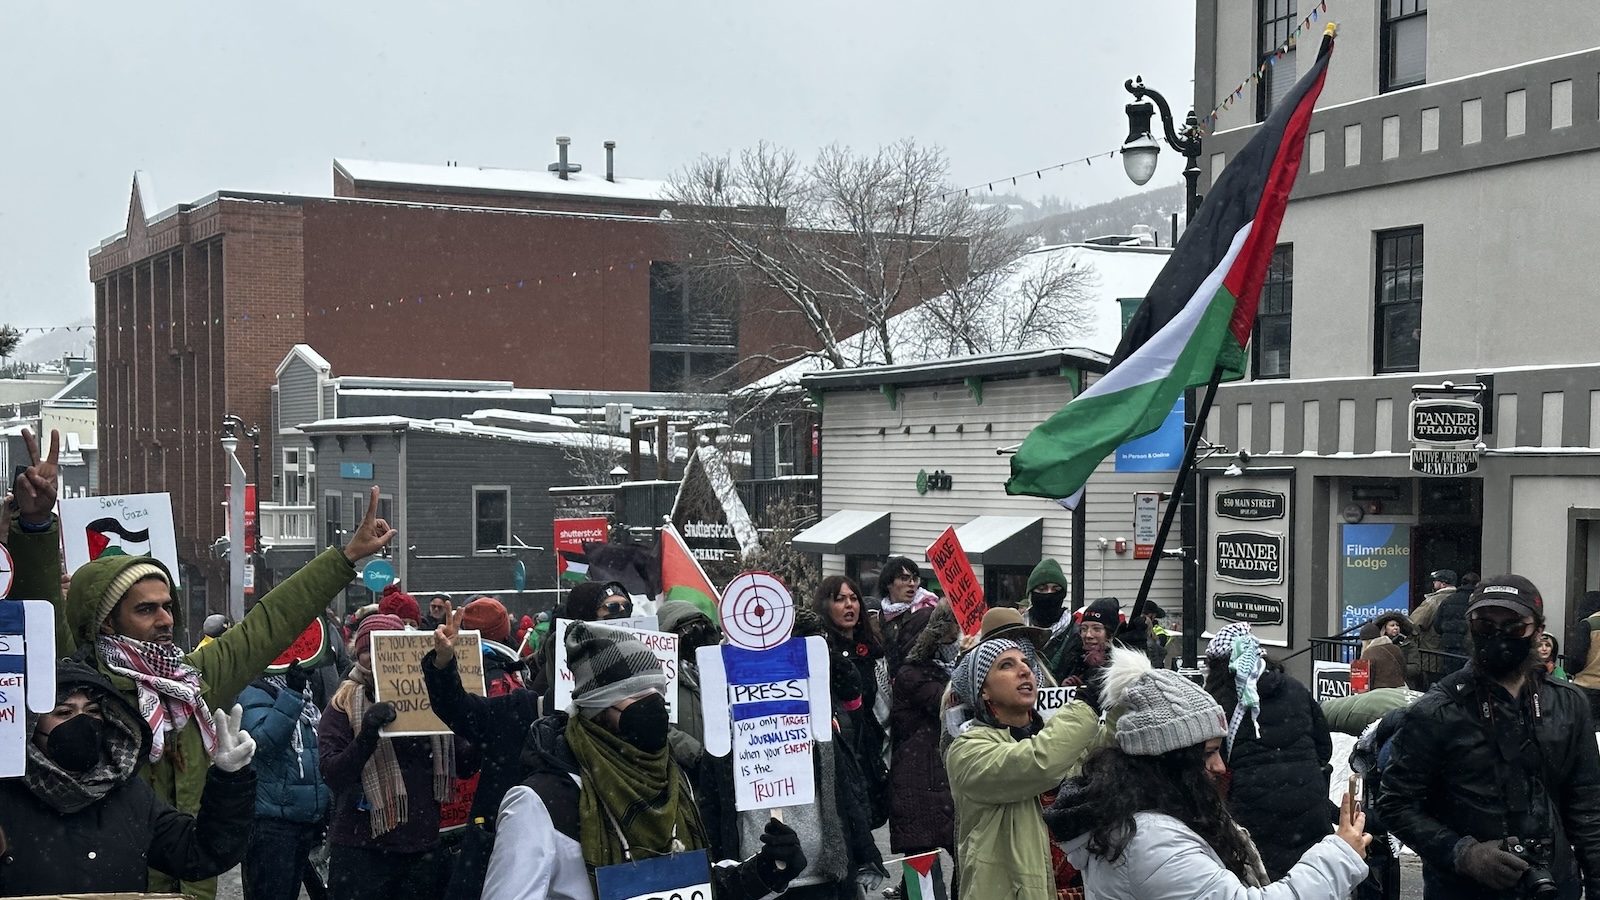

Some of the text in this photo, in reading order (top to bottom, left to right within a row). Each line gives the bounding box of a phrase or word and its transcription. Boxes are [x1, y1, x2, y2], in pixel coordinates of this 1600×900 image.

[1416, 412, 1477, 426] TANNER
[1417, 426, 1477, 435] TRADING
[1413, 451, 1478, 463] NATIVE AMERICAN
[1421, 463, 1470, 475] JEWELRY
[100, 497, 125, 509] Save
[1234, 499, 1250, 507] MAIN
[1251, 500, 1275, 508] STREET
[122, 506, 149, 521] Gaza
[694, 549, 725, 561] CHALET
[932, 537, 955, 571] THOSE
[1219, 542, 1278, 560] TANNER
[1220, 558, 1278, 572] TRADING
[1346, 557, 1388, 570] Lodge
[1221, 601, 1243, 610] FAMILY
[1244, 603, 1280, 613] TRADITION
[375, 638, 385, 651] IF
[420, 636, 436, 648] EVE
[377, 651, 405, 662] WHAT
[734, 680, 804, 702] PRESS
[1319, 678, 1351, 697] TAN
[1036, 688, 1077, 711] RESIS
[760, 716, 778, 730] only
[780, 715, 809, 726] TARGET
[748, 727, 808, 746] JOURNALISTS
[740, 740, 811, 761] when your ENEMY
[754, 763, 774, 775] the
[750, 776, 796, 803] TRUTH
